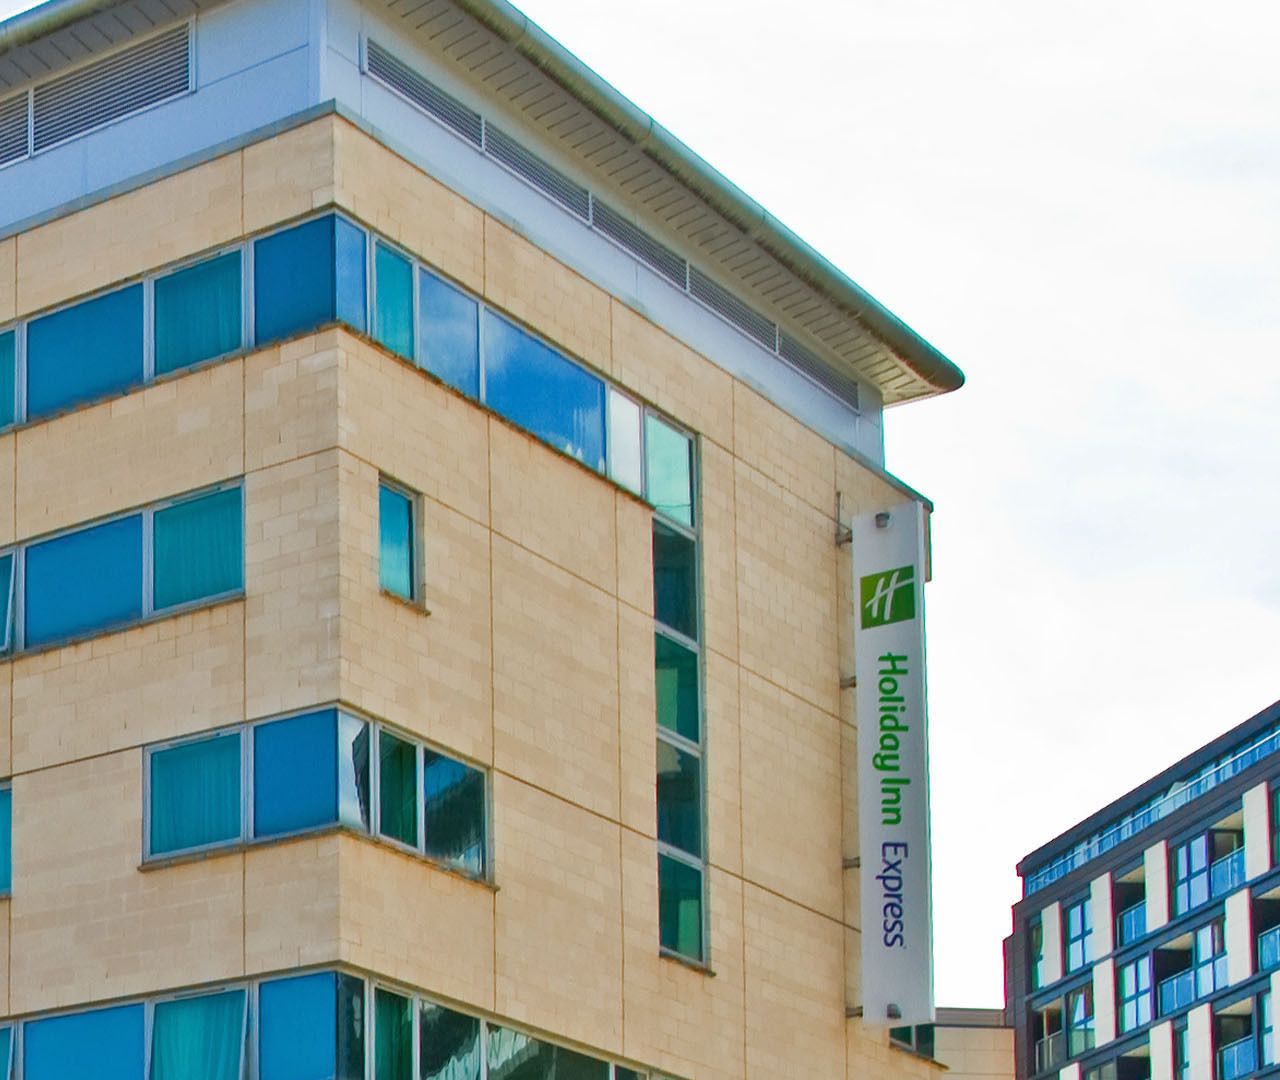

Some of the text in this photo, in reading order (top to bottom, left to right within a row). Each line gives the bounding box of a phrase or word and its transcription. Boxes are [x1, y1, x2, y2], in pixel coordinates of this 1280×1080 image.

[872, 652, 911, 948] Holiday Inn Express
